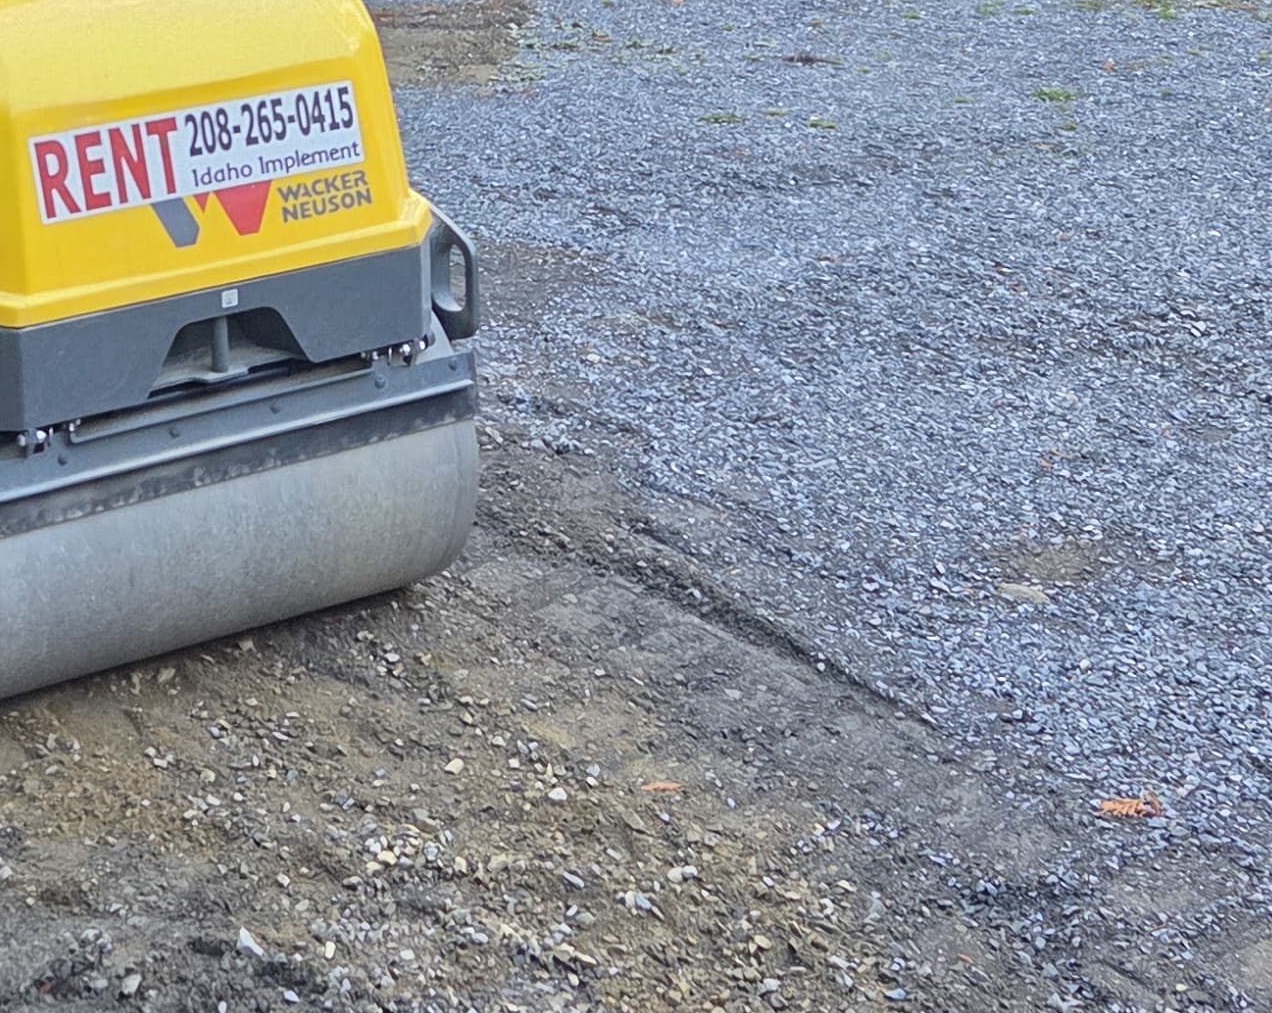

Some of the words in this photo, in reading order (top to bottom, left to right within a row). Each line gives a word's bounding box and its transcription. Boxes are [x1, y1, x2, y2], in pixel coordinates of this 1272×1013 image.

[185, 86, 354, 157] 208-265-0415
[34, 117, 177, 219] RENT
[192, 162, 253, 187] Idaho
[258, 141, 360, 174] Implement
[277, 170, 368, 203] WACKER
[282, 188, 372, 223] NEUSON
